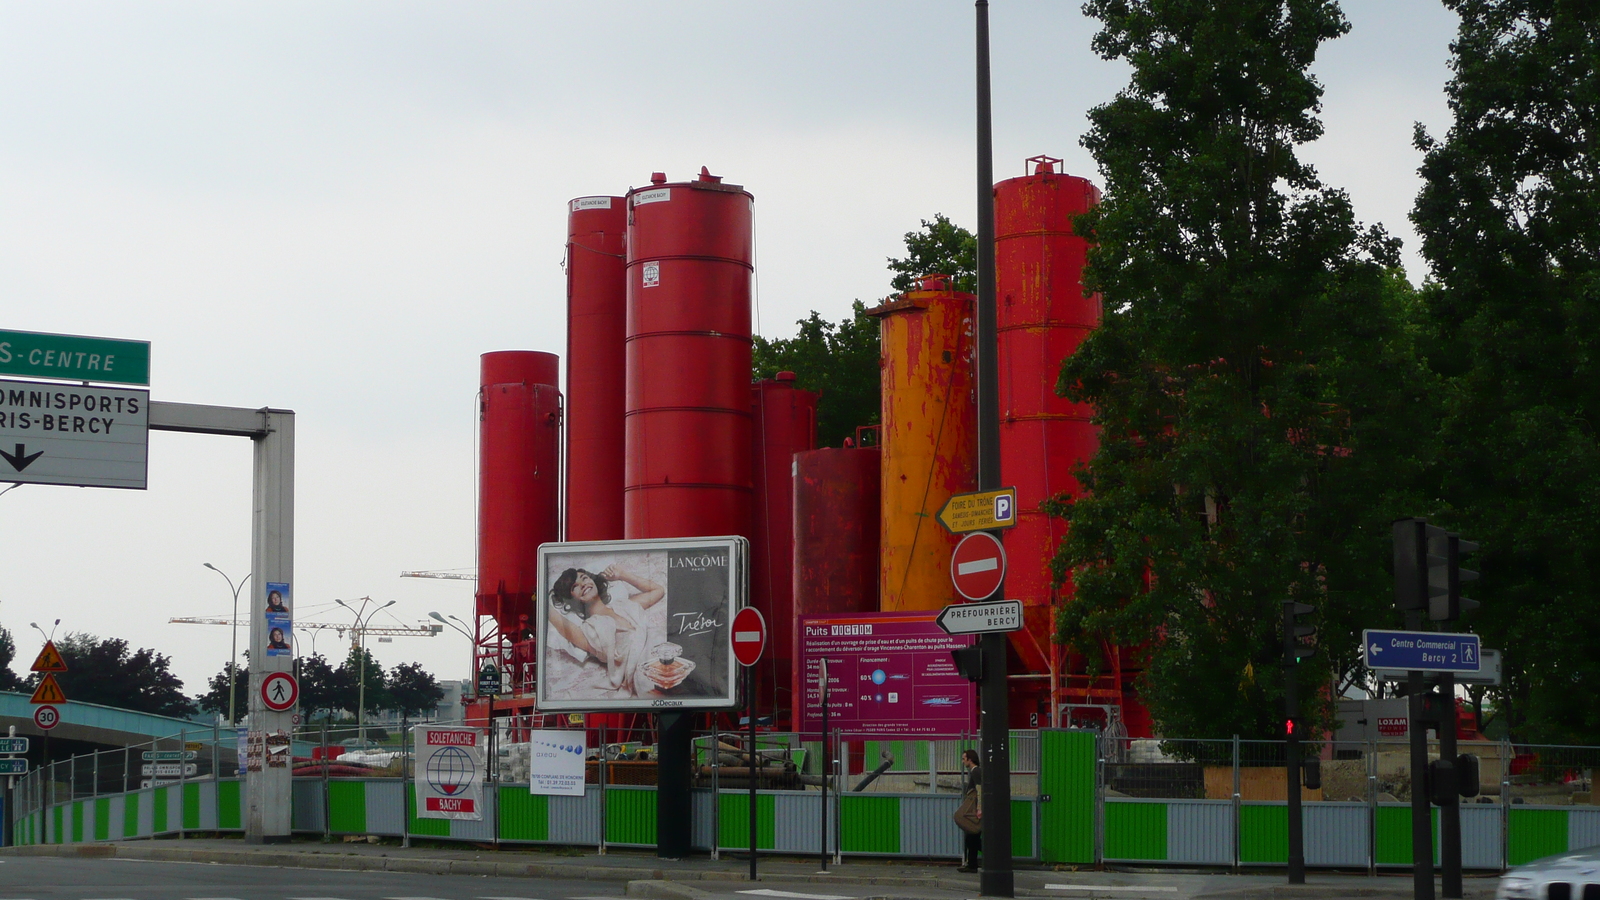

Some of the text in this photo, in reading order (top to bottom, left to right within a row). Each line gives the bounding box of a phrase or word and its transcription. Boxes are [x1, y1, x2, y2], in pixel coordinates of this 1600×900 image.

[968, 500, 975, 508] DU
[669, 554, 728, 568] LANCÔME
[951, 606, 1016, 618] PRÉFOURRIÈRE
[673, 612, 724, 635] Trésor
[987, 617, 1016, 626] BERCY
[806, 626, 828, 636] Puits
[863, 645, 879, 653] d'orage
[1391, 638, 1456, 650] Centre Commercial
[1422, 653, 1457, 664] Bercy 2
[40, 713, 54, 722] 30
[1030, 713, 1037, 726] 2
[430, 732, 472, 745] SOLETANCHE
[439, 799, 461, 810] BACHY
